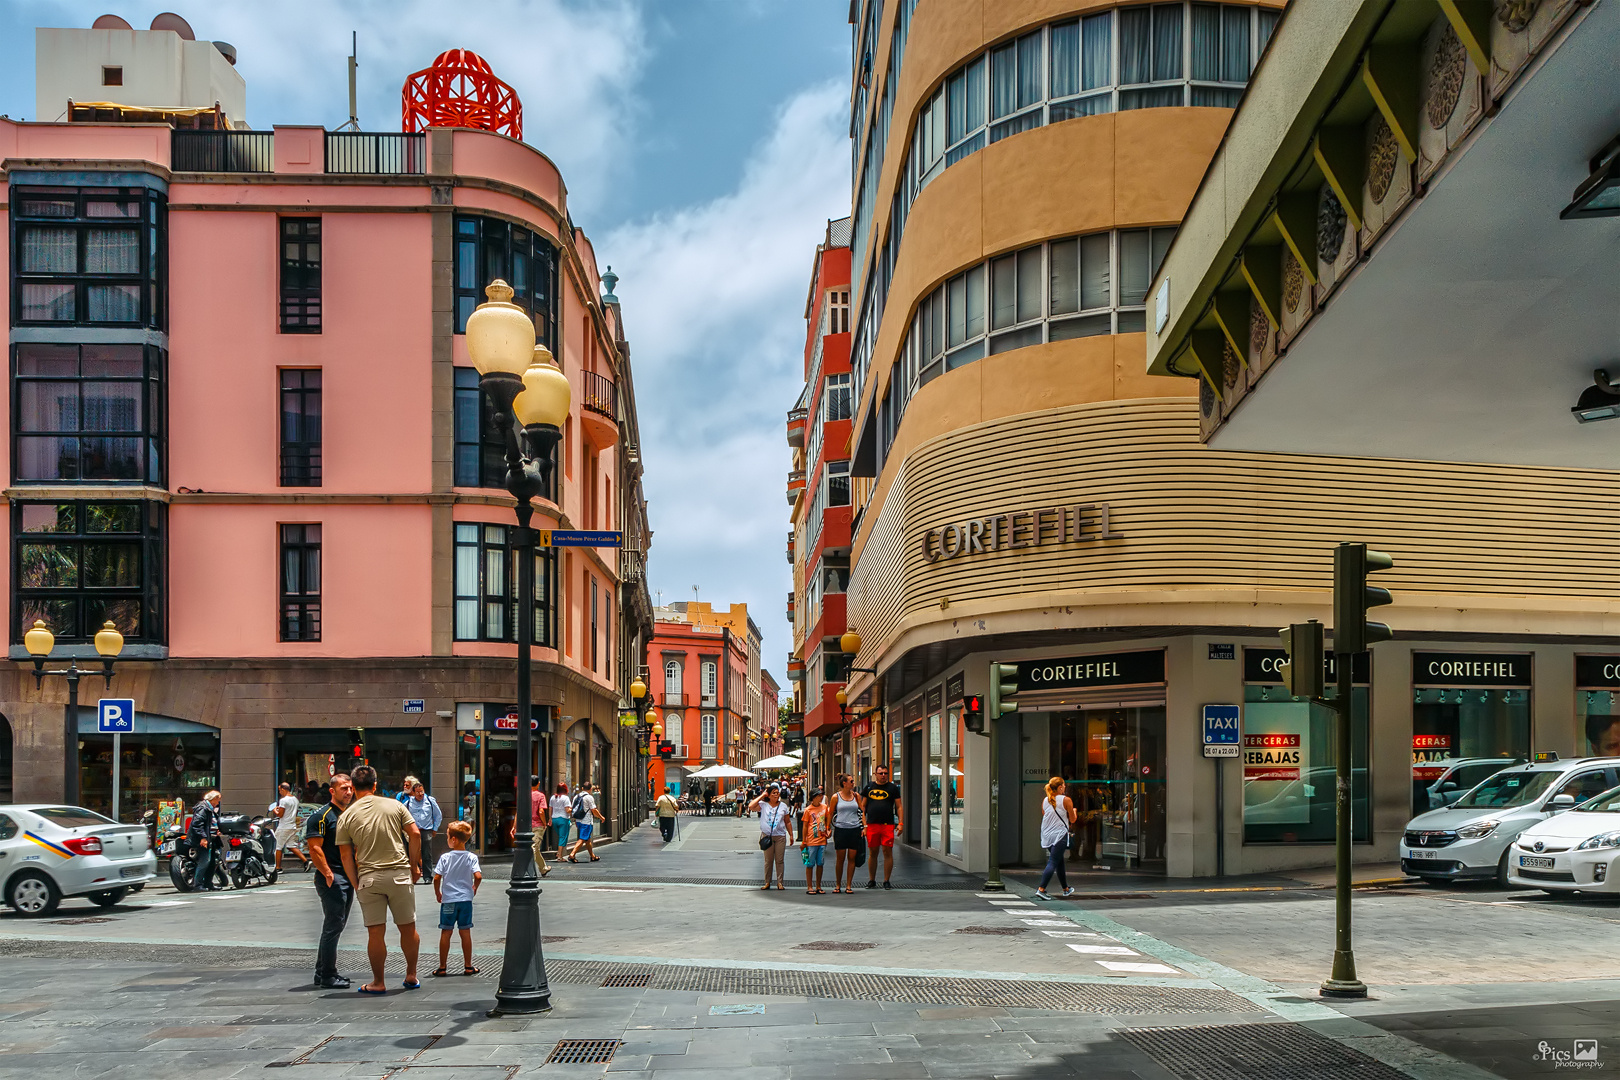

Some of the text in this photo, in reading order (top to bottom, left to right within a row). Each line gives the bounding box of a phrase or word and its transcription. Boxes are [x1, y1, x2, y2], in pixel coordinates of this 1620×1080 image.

[921, 503, 1124, 563] CORTEFIEL
[1031, 662, 1120, 682] CORTEFIEL
[1428, 661, 1516, 678] CORTEFIEL
[104, 705, 122, 726] P
[1206, 718, 1237, 729] TAXI
[1244, 737, 1296, 745] TERCERAS
